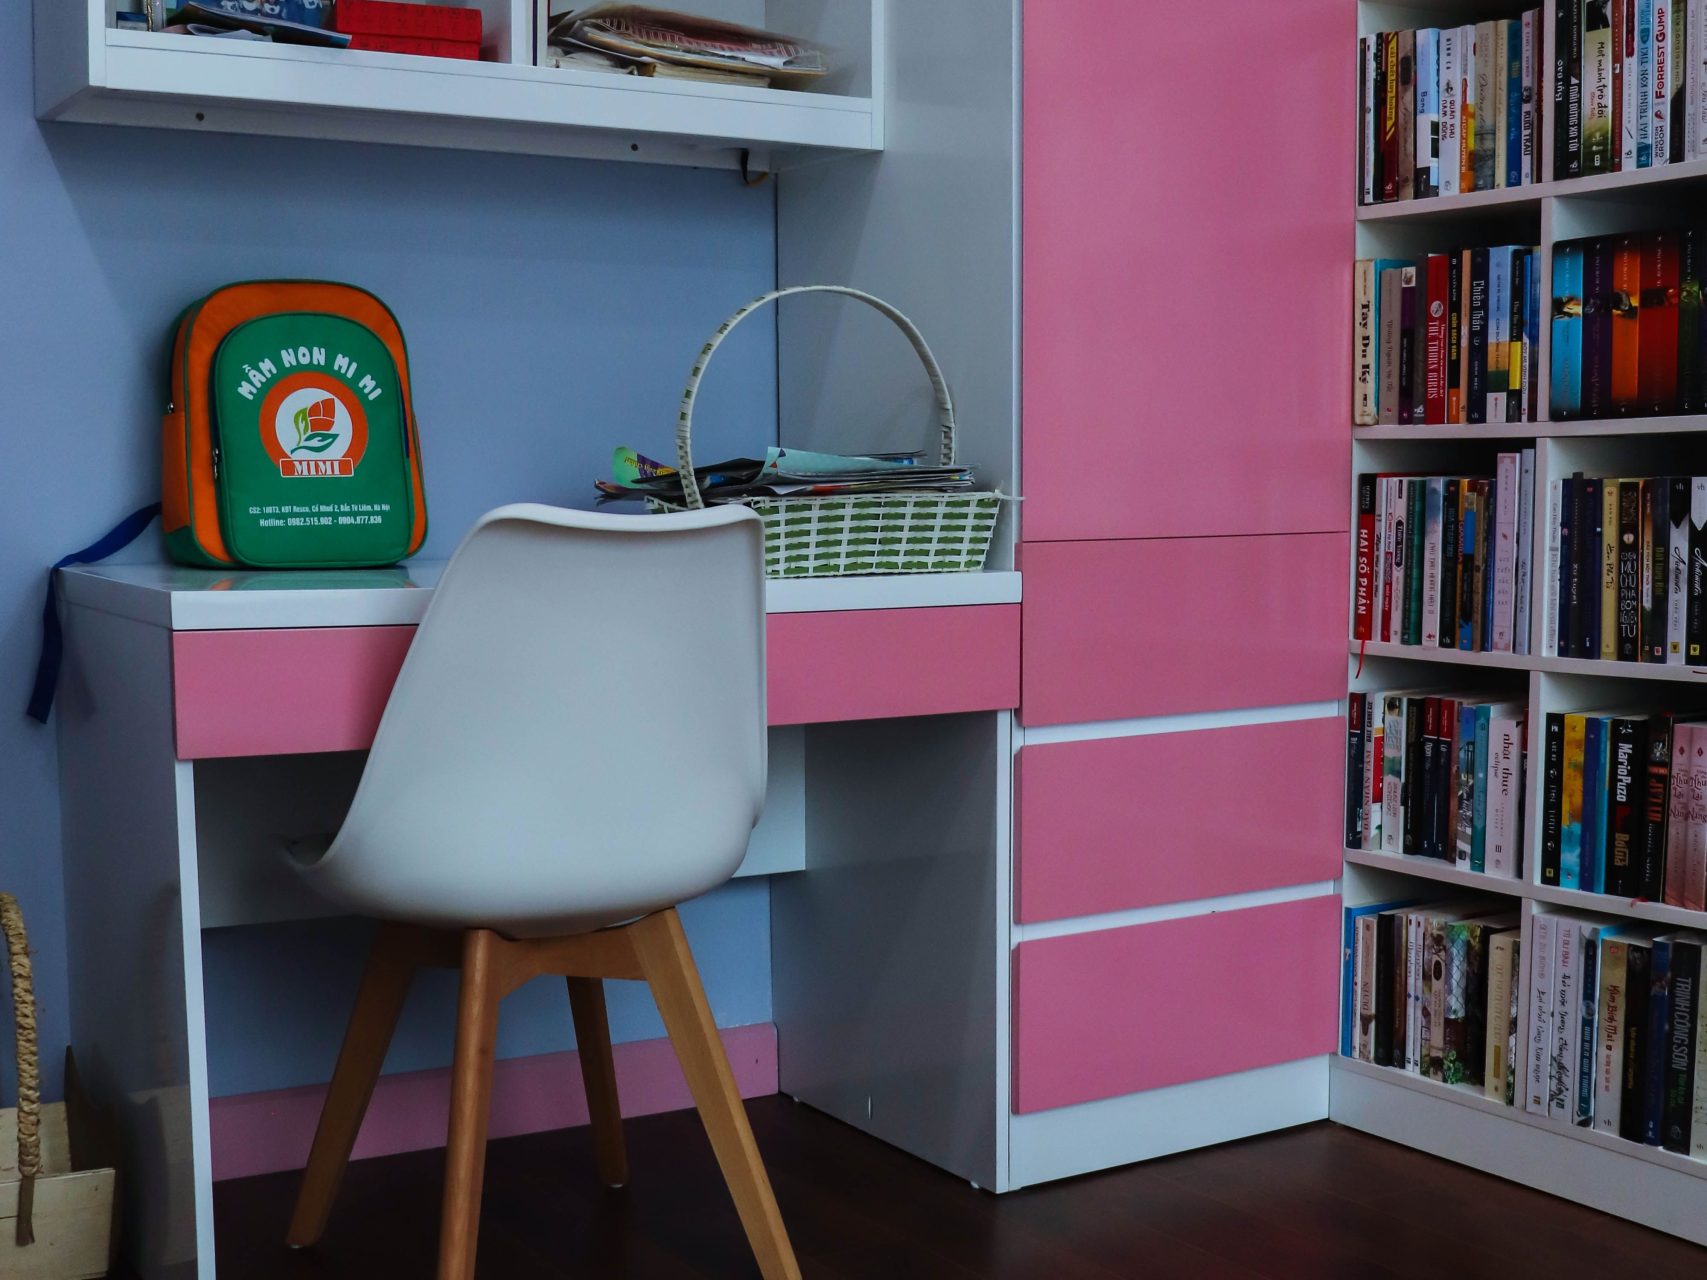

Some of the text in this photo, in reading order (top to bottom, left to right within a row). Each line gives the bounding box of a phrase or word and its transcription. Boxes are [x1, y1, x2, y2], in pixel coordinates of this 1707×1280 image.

[1596, 59, 1606, 82] mảnh
[1655, 8, 1665, 99] FORREST GUMP
[1568, 86, 1578, 152] MÃI ĐỪNG XA TÔI
[1361, 335, 1370, 358] Du
[1428, 320, 1439, 398] THE THORN BIRDS
[281, 346, 325, 368] NON
[333, 353, 358, 379] MI
[358, 374, 383, 401] MI
[1359, 364, 1370, 384] Ký
[293, 460, 340, 475] MIMI
[1358, 529, 1369, 614] HAI SỐ PHẬN
[1671, 547, 1686, 594] Archimedes
[1691, 547, 1707, 596] Archimedes
[1491, 752, 1500, 779] eclipse
[1617, 743, 1633, 802] Mario Puzo
[1671, 977, 1692, 1071] TRỊNH CÔNG SƠN
